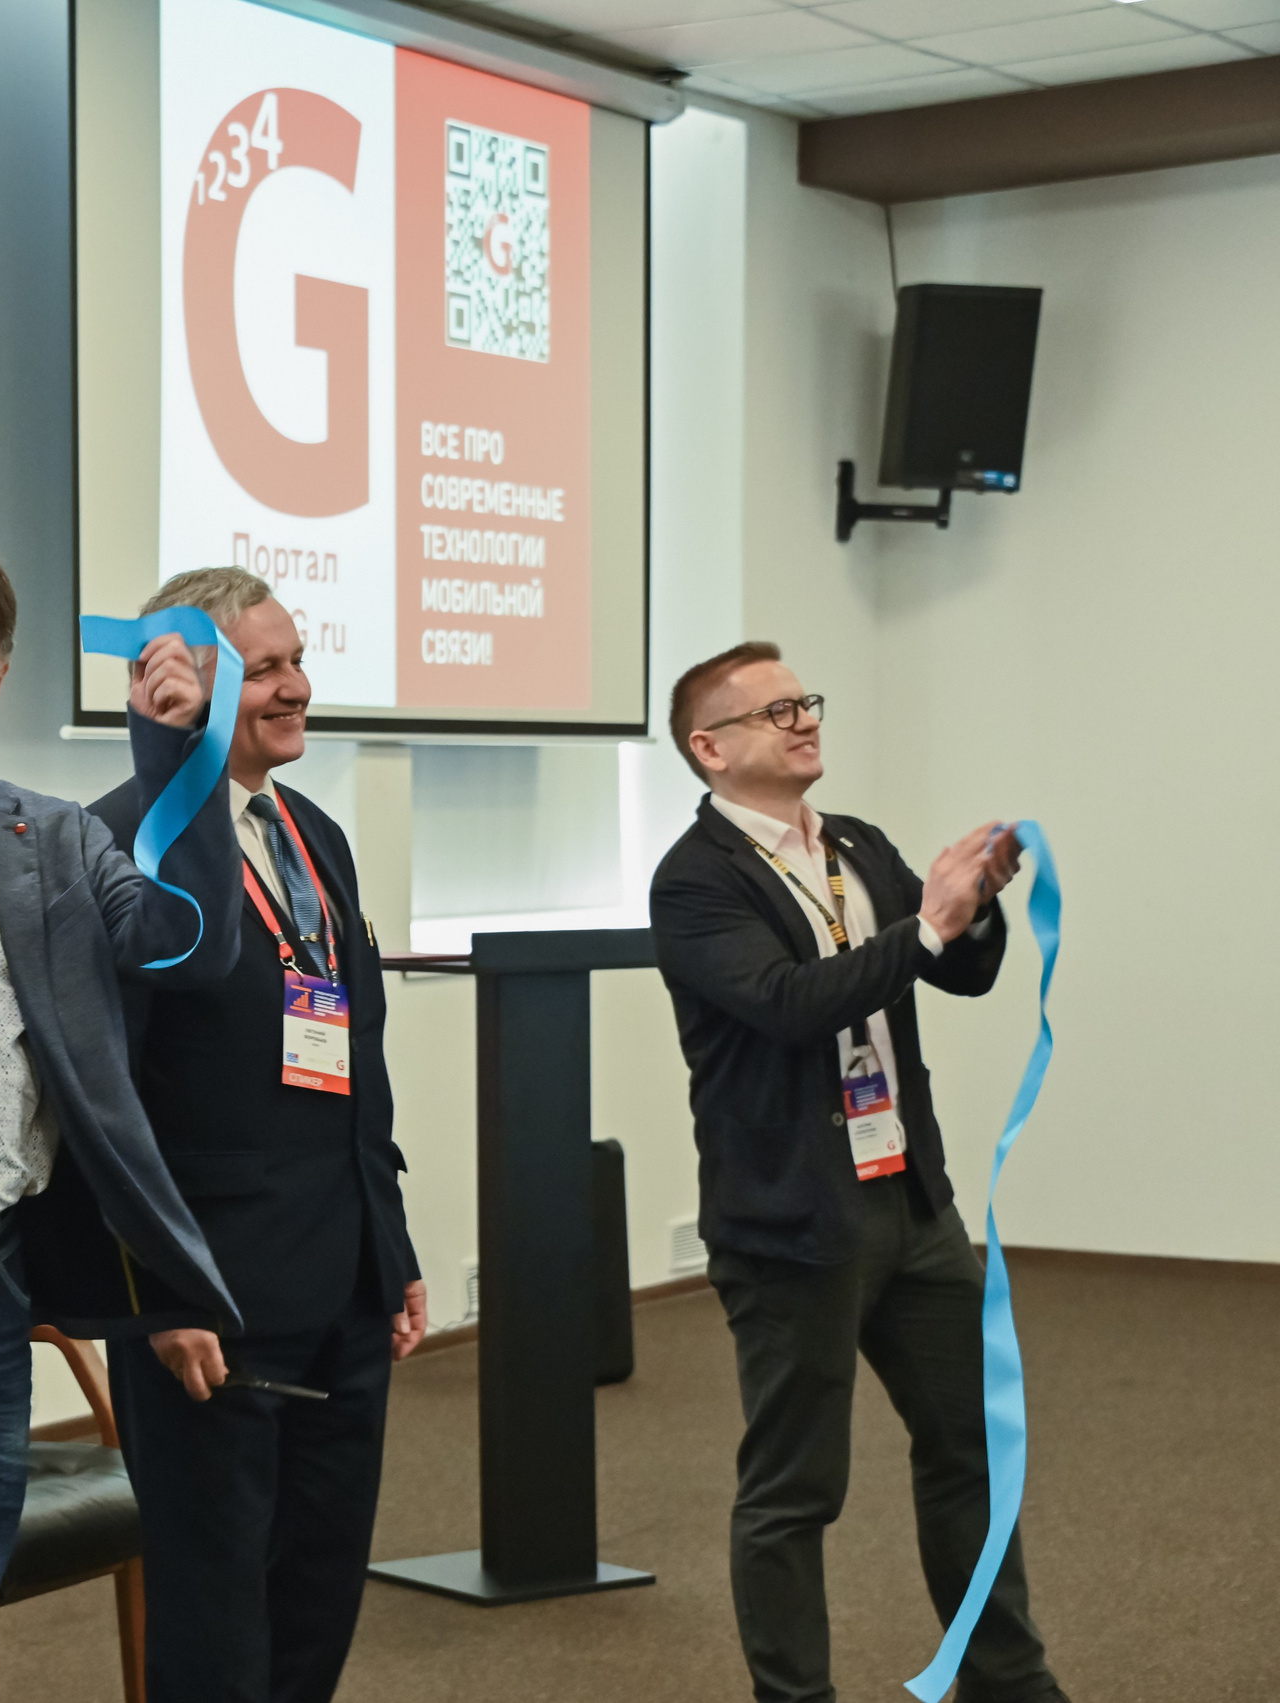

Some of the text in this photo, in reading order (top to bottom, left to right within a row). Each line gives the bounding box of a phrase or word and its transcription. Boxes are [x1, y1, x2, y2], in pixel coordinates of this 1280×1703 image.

[421, 420, 504, 465] ВСЕ ПРО
[421, 472, 565, 522] СОВРЕМЕННЫЕ
[233, 532, 338, 589] Портал
[420, 524, 546, 568] ТЕХНОЛОГИИ
[421, 576, 545, 618] МОБИЛЬНОЙ
[421, 628, 494, 666] СВЯЗИ!
